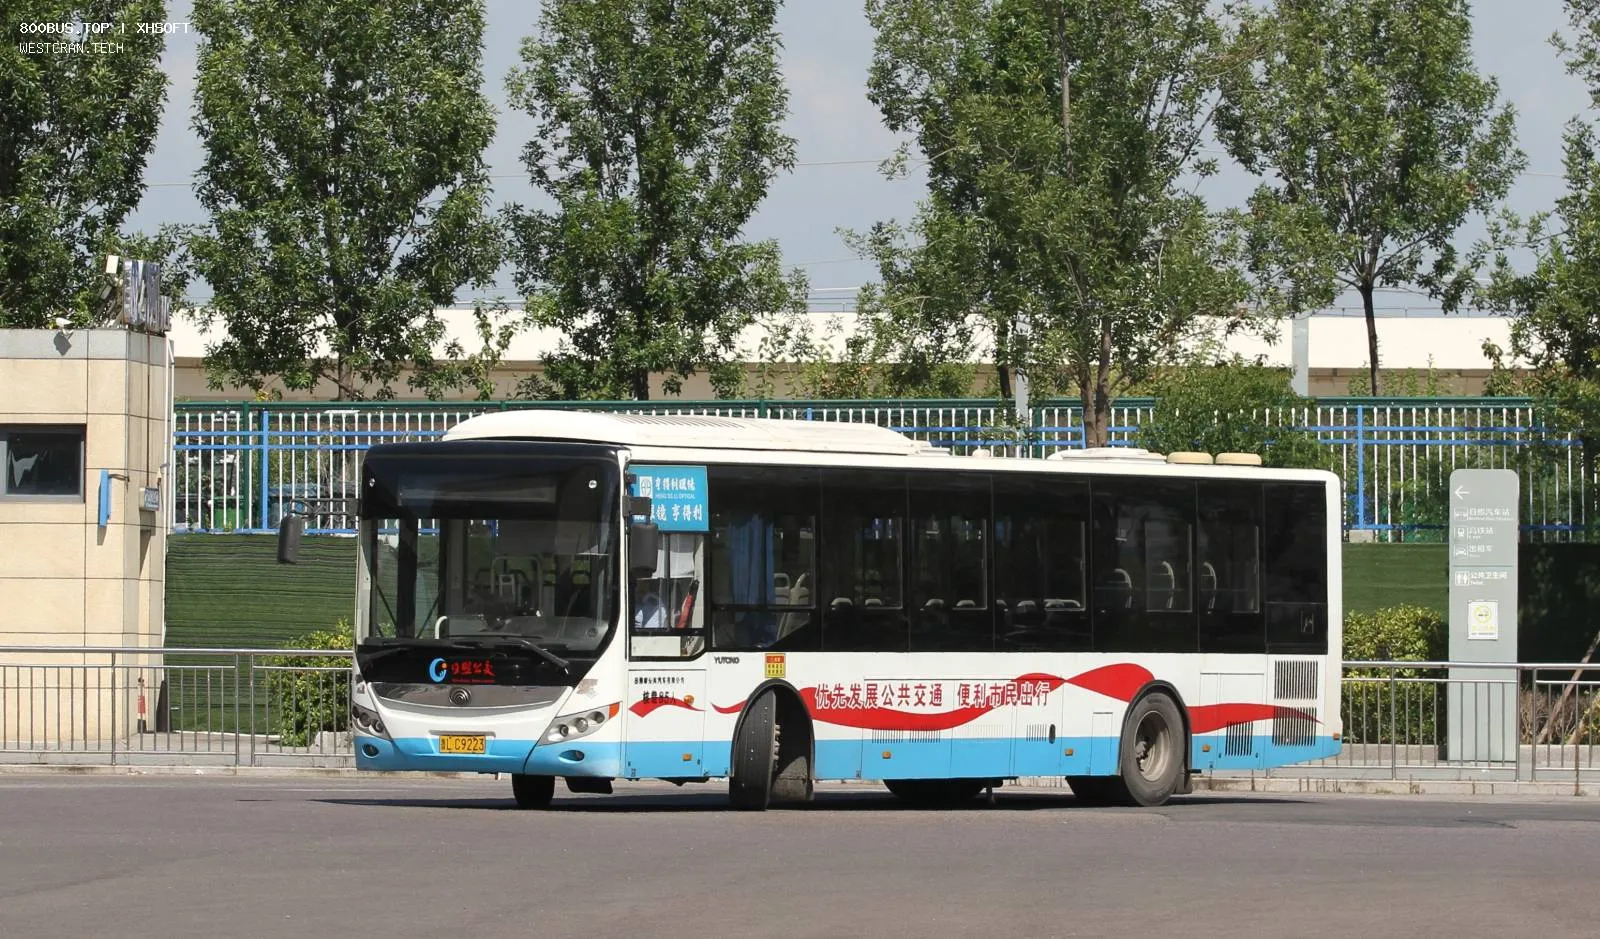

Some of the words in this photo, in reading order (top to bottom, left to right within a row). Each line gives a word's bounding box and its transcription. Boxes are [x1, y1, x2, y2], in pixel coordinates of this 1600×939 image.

[816, 682, 943, 709] 优先发展公共交通
[957, 680, 1051, 707] 便利市民出行
